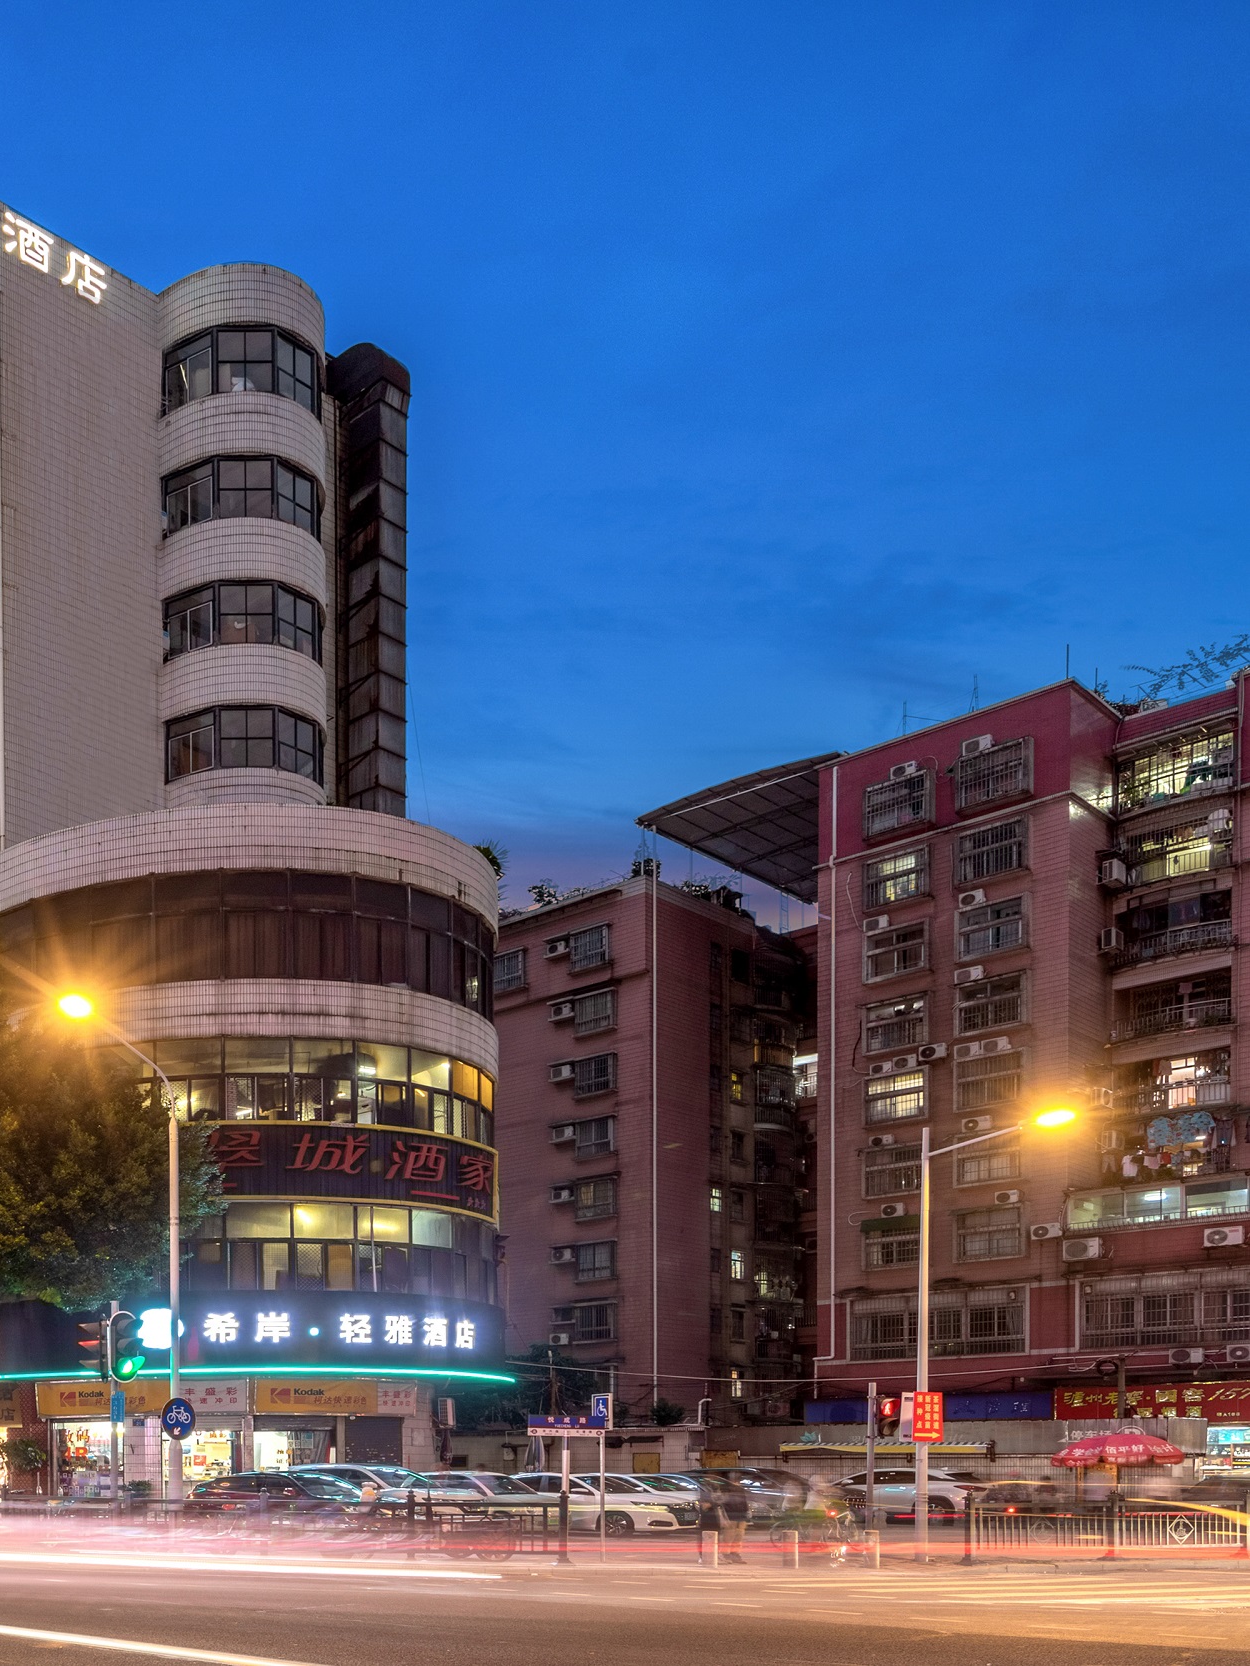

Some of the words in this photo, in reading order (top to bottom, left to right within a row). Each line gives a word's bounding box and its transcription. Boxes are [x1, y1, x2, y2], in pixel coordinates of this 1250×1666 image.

[2, 211, 108, 305] 酒店
[78, 1390, 105, 1398] Kodak
[294, 1387, 325, 1396] Kodak
[95, 1395, 146, 1405] 柯达彩色
